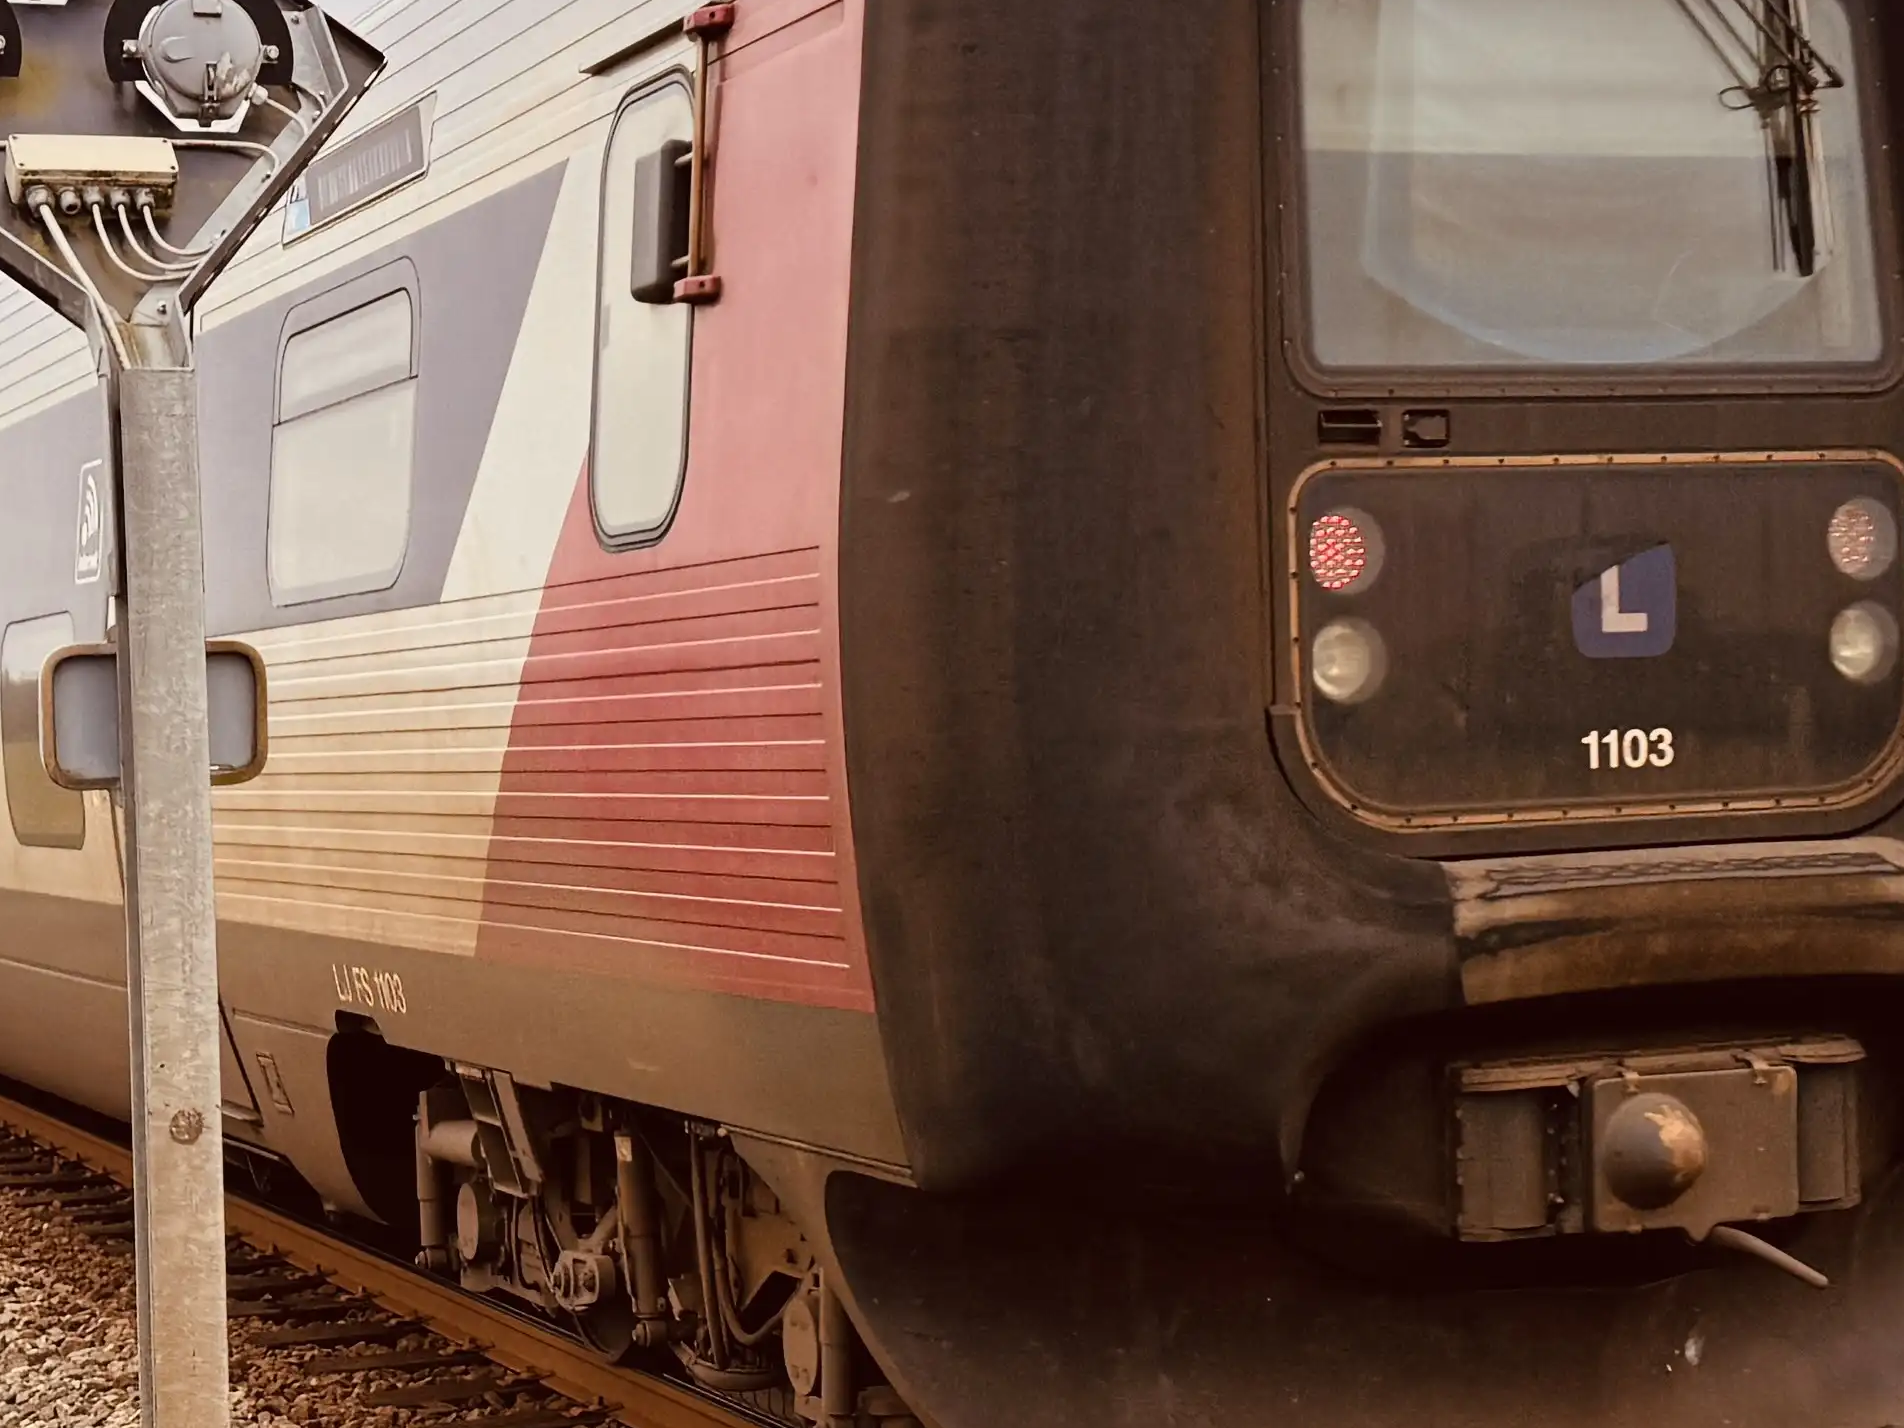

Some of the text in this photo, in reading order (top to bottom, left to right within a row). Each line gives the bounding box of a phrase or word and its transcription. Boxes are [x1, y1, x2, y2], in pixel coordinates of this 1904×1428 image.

[1600, 564, 1648, 633] L
[1581, 728, 1675, 770] 1103
[373, 969, 407, 1014] 1103
